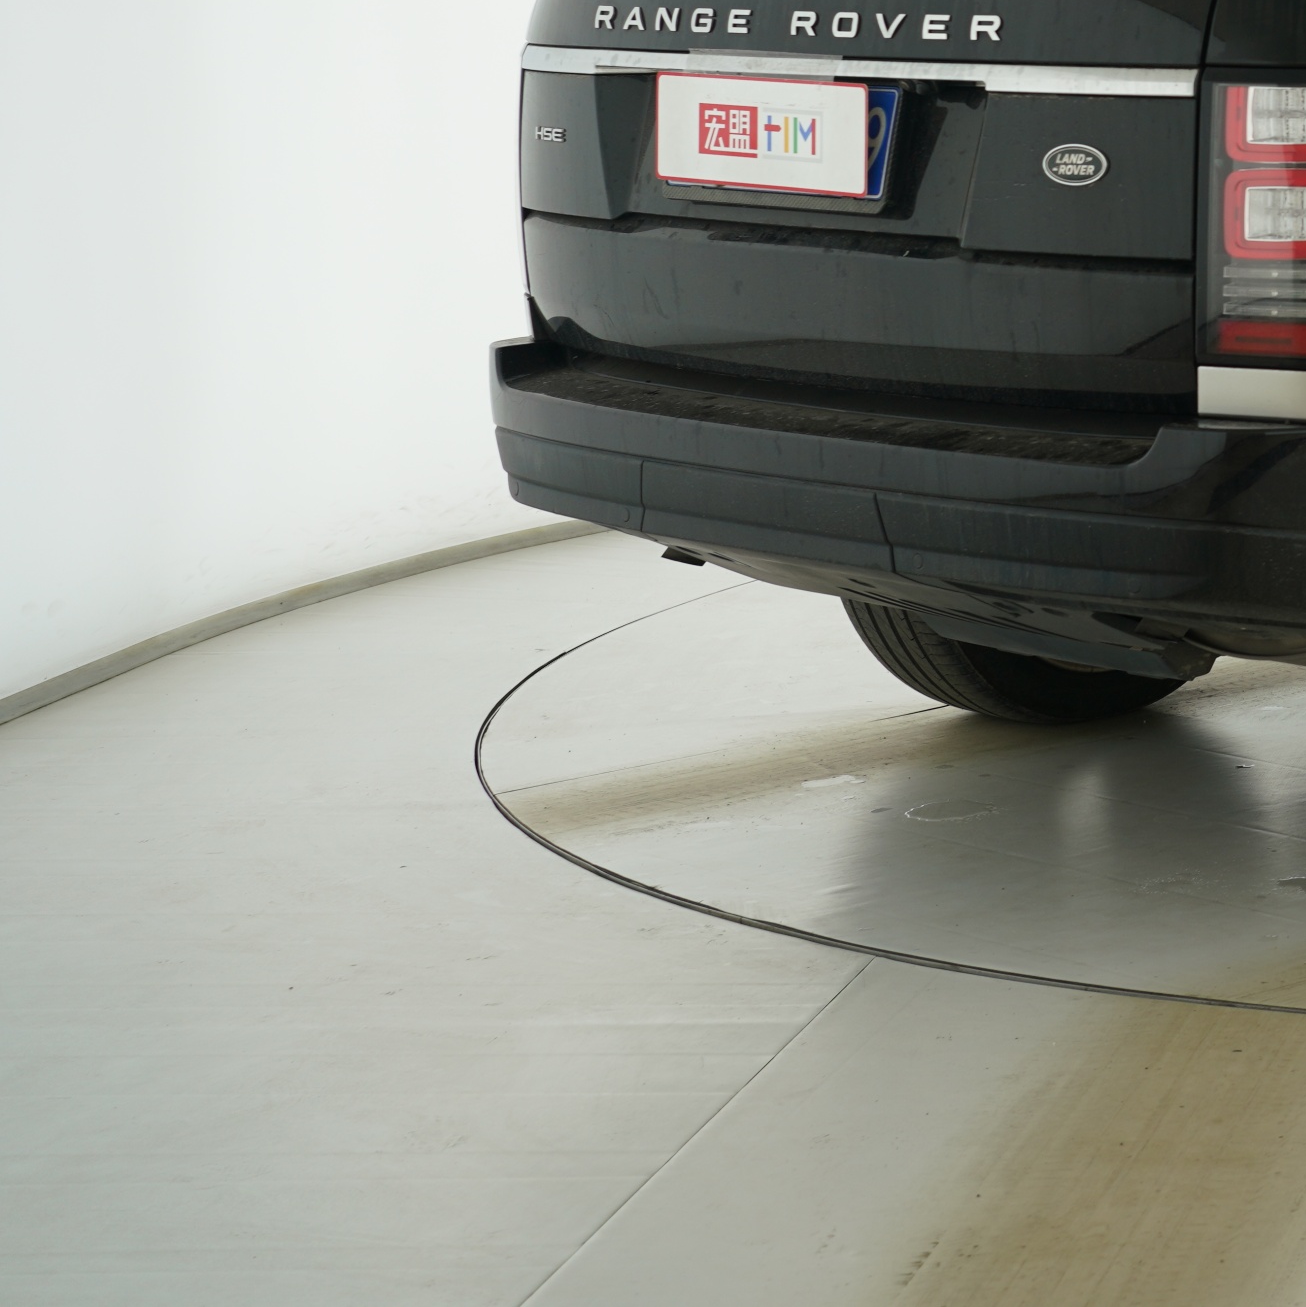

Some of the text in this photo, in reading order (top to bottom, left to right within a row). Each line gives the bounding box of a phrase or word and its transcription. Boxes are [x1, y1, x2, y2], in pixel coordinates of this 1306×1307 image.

[594, 4, 1003, 42] RANGE ROVER
[535, 126, 567, 143] HSE
[703, 108, 757, 154] 宏盟
[1055, 153, 1086, 165] LAND
[1057, 164, 1096, 176] ROVER
